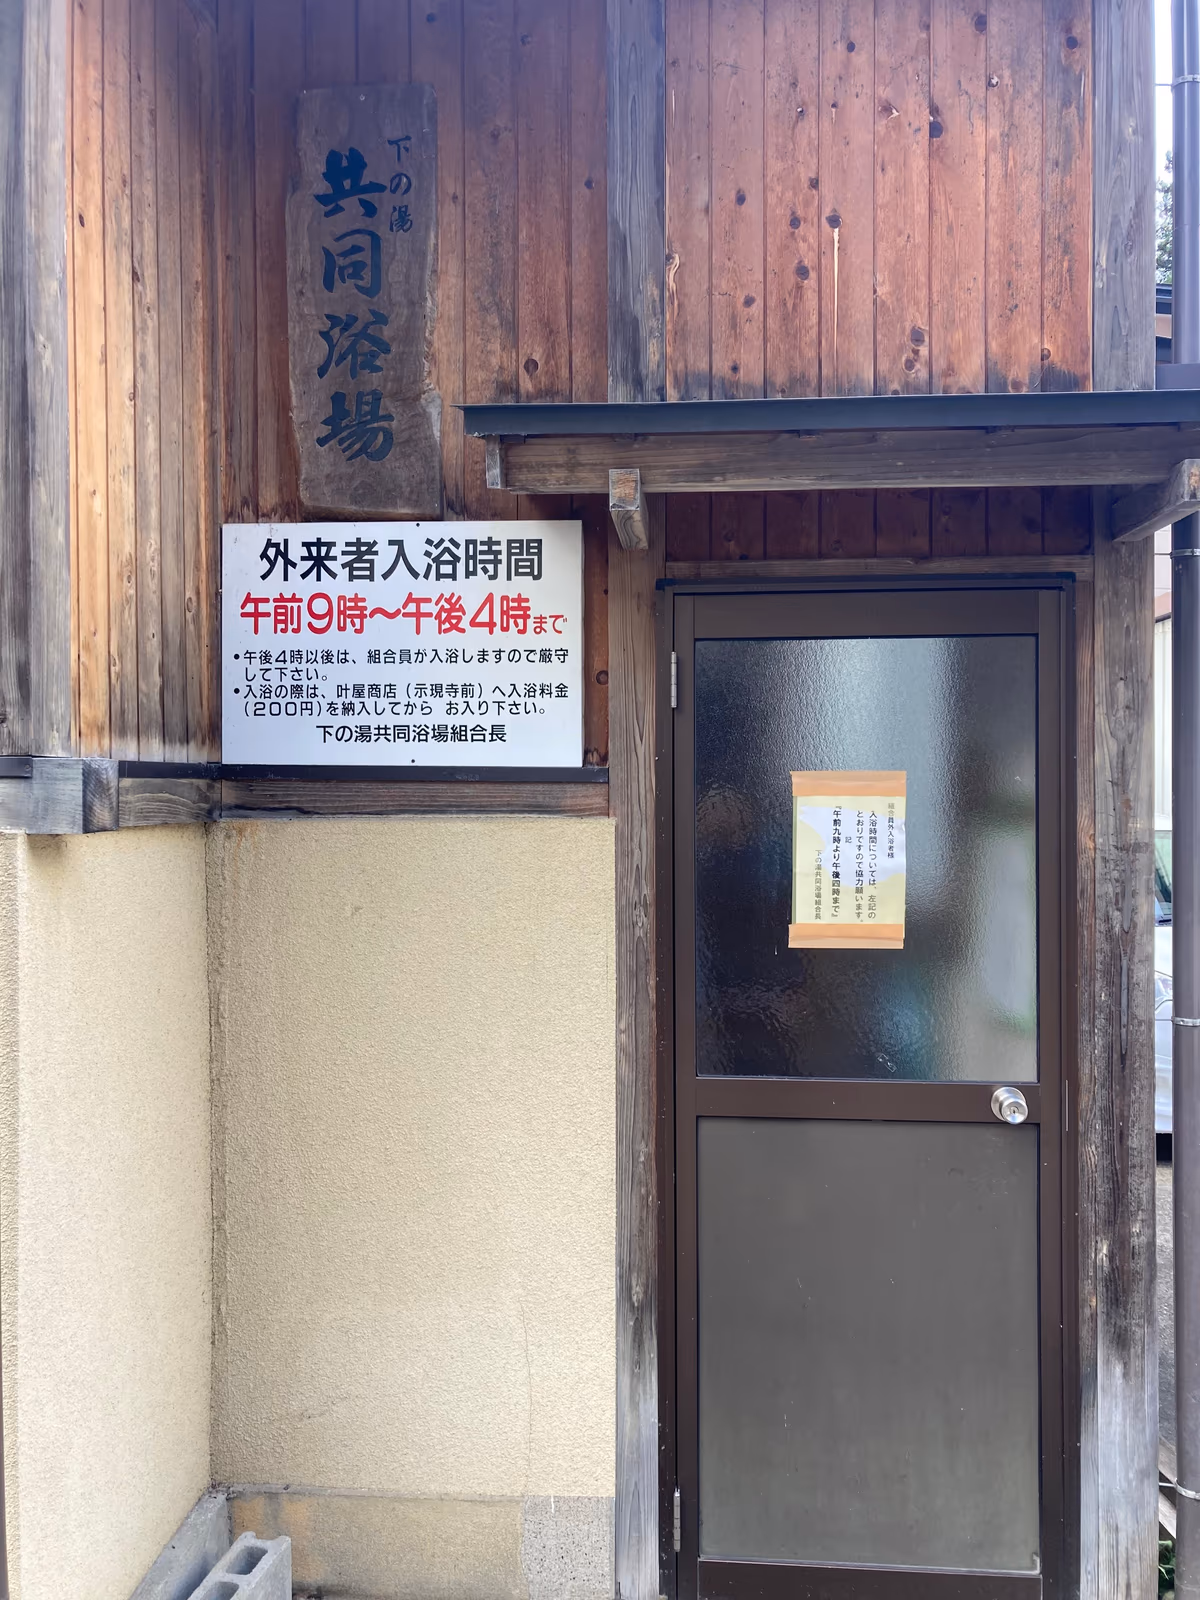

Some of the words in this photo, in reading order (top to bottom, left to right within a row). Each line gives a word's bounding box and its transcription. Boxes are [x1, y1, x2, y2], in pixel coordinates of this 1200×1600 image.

[387, 135, 413, 233] 下の湯
[314, 146, 394, 462] 共同浴場
[260, 537, 543, 582] 外来者入浴時間
[244, 667, 329, 682] して下さい。
[316, 724, 507, 743] 下の湯共同浴場組合長
[814, 850, 822, 920] 下の湯共同浴場組合長
